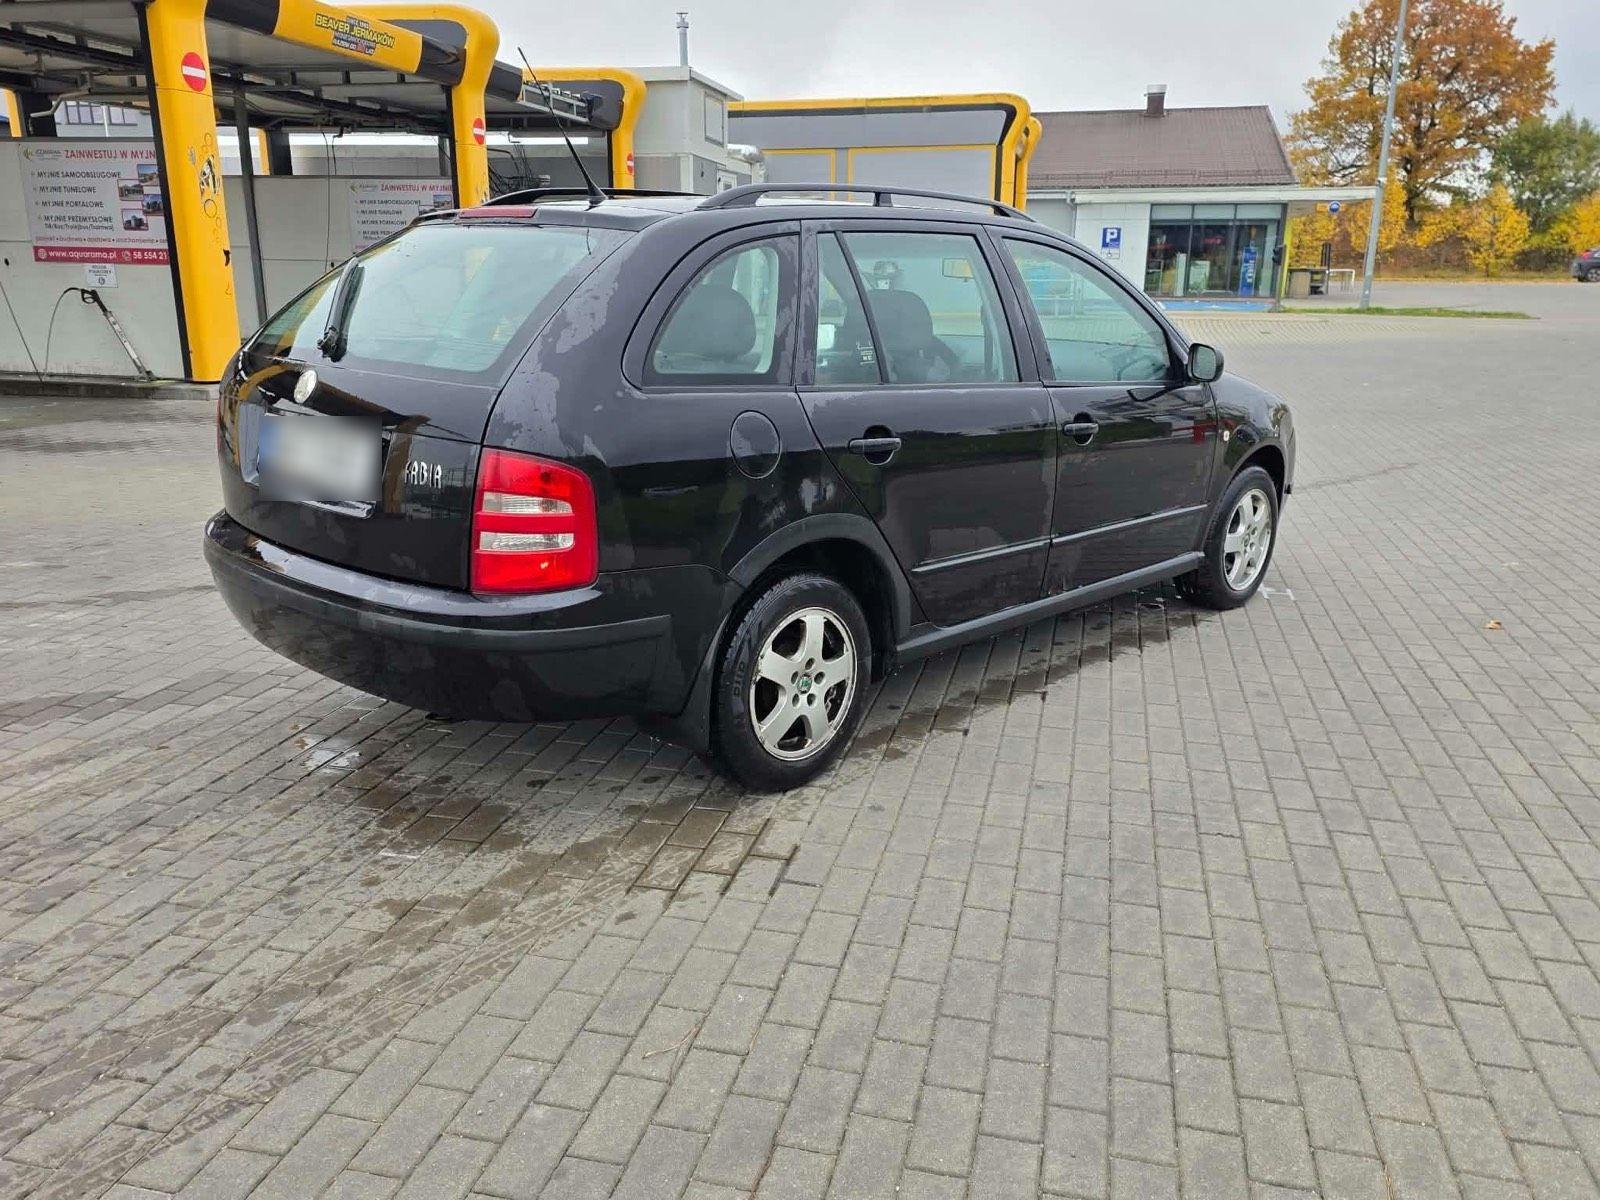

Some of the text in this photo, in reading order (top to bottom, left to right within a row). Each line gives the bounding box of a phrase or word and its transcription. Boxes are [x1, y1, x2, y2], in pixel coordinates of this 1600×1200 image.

[316, 14, 350, 33] BEAVER
[352, 27, 395, 47] JERMAKÓW
[64, 149, 117, 160] ZAINWESTUJ
[120, 150, 129, 159] W
[131, 150, 155, 160] MYJN
[61, 171, 121, 179] SAMOOBSŁUGOWE
[41, 200, 64, 208] MYJNIE
[68, 215, 113, 223] PRZEMYSŁOWE
[1105, 228, 1118, 243] P
[48, 249, 117, 260] www.aquarama.pl
[133, 251, 143, 259] 58
[143, 251, 157, 260] 554
